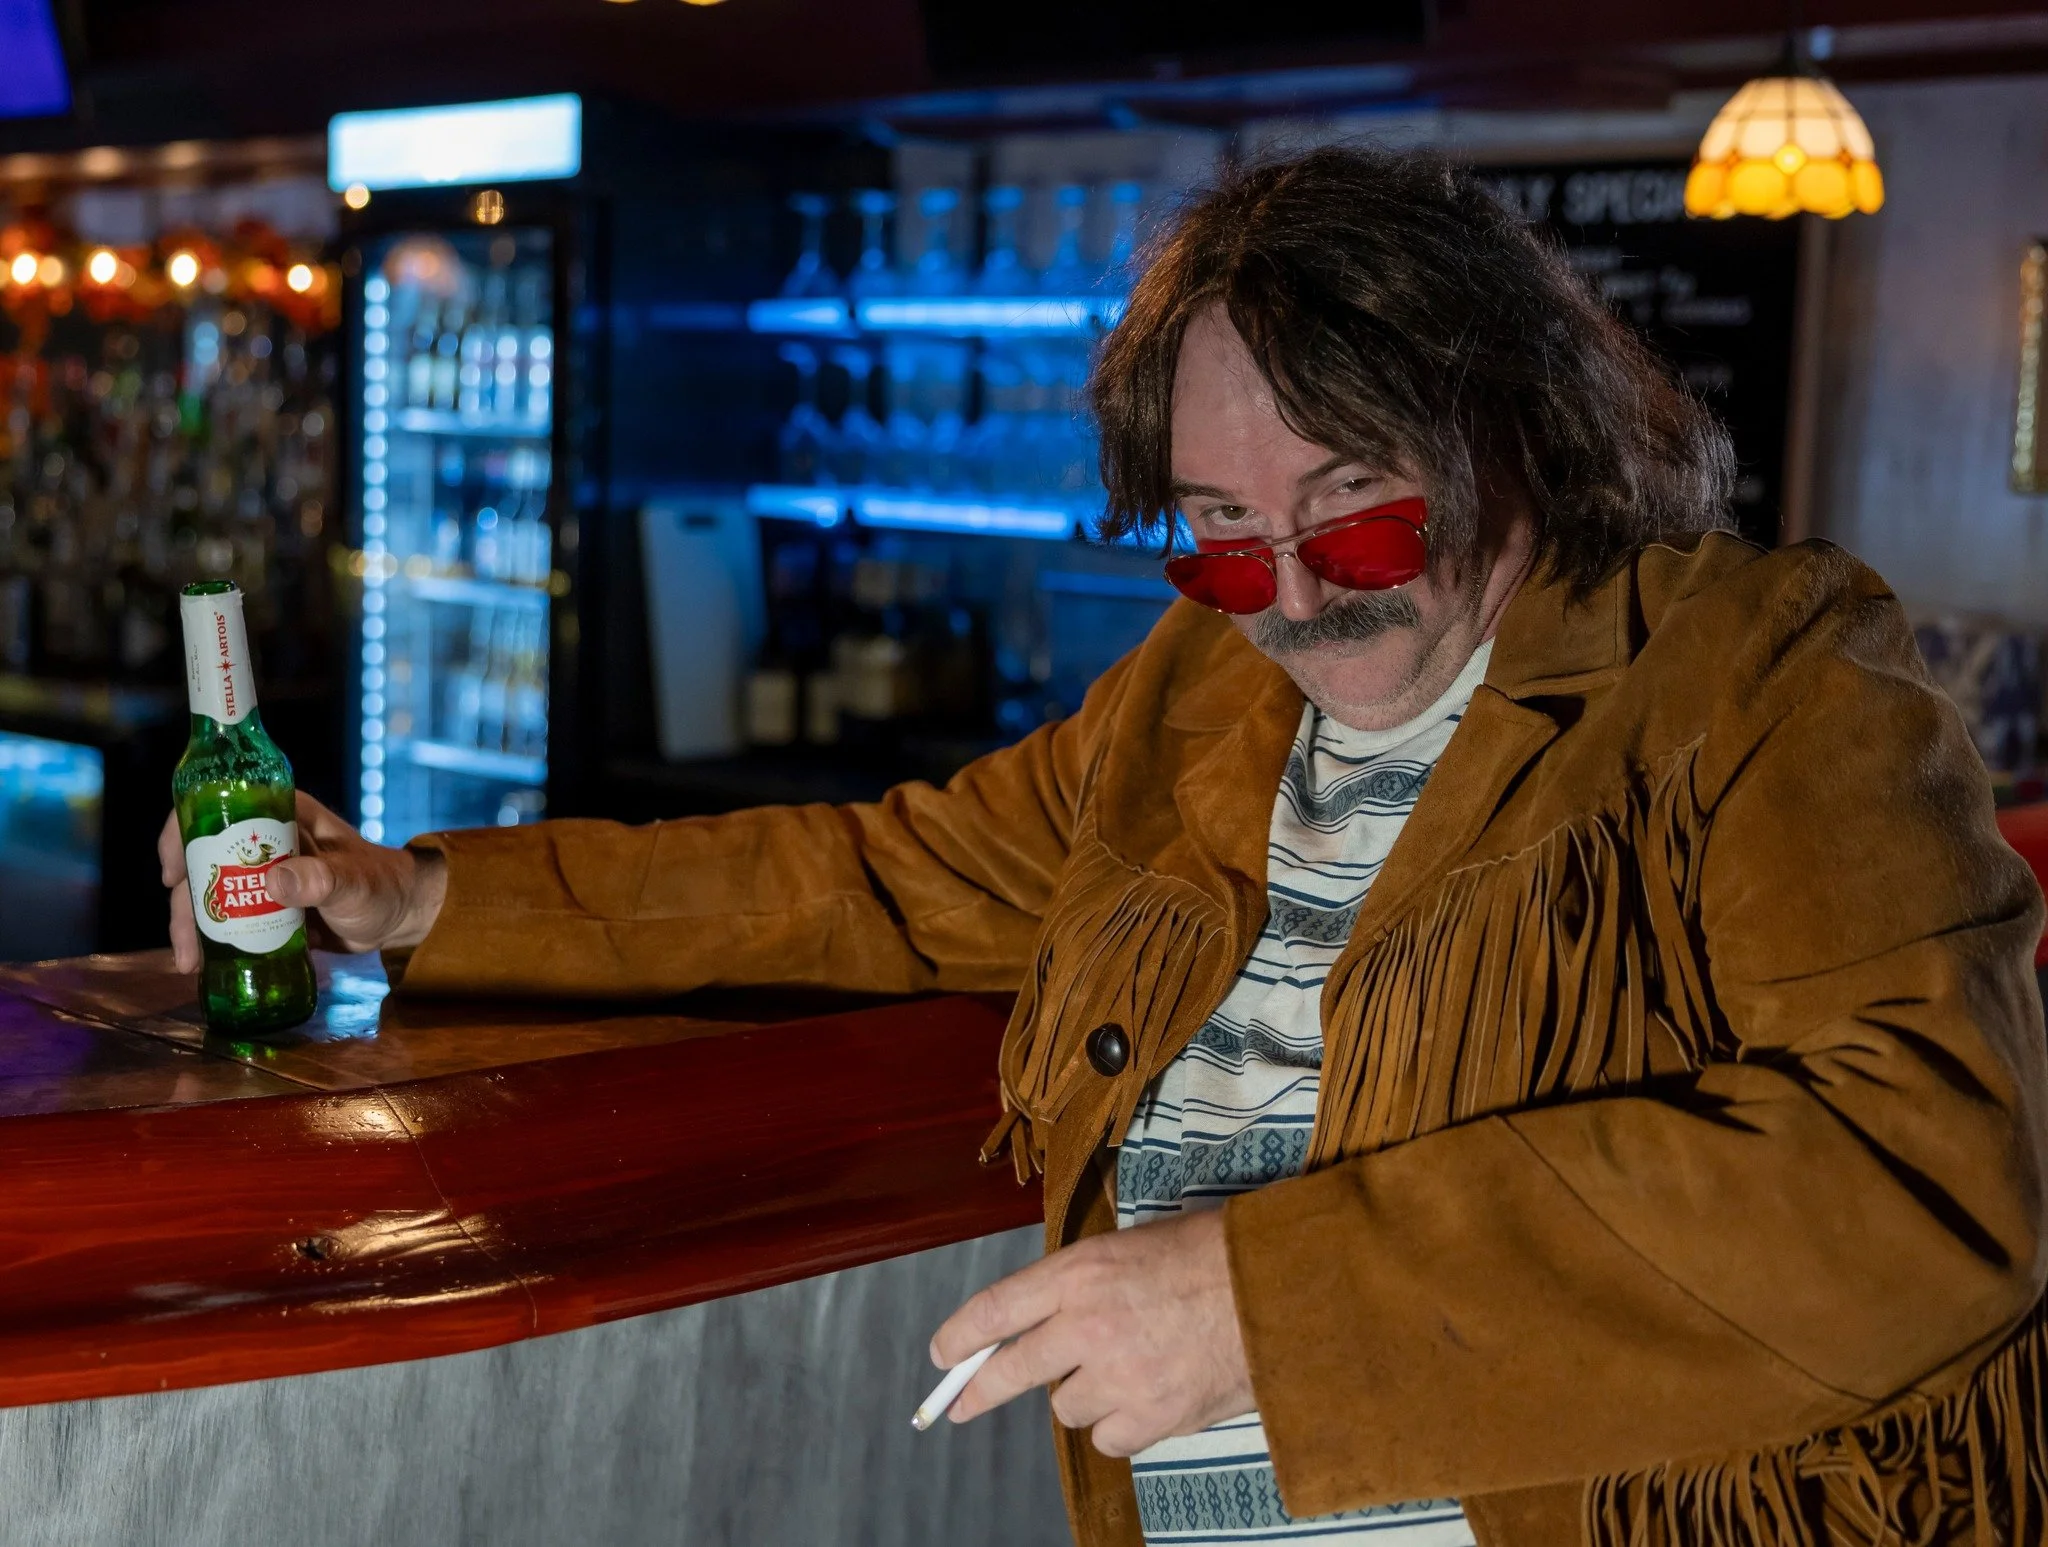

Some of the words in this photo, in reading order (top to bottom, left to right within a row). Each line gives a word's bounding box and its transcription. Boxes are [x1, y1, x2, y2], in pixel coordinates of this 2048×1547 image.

[223, 674, 236, 717] STELLA
[222, 873, 266, 891] STEL
[224, 890, 274, 908] ART
